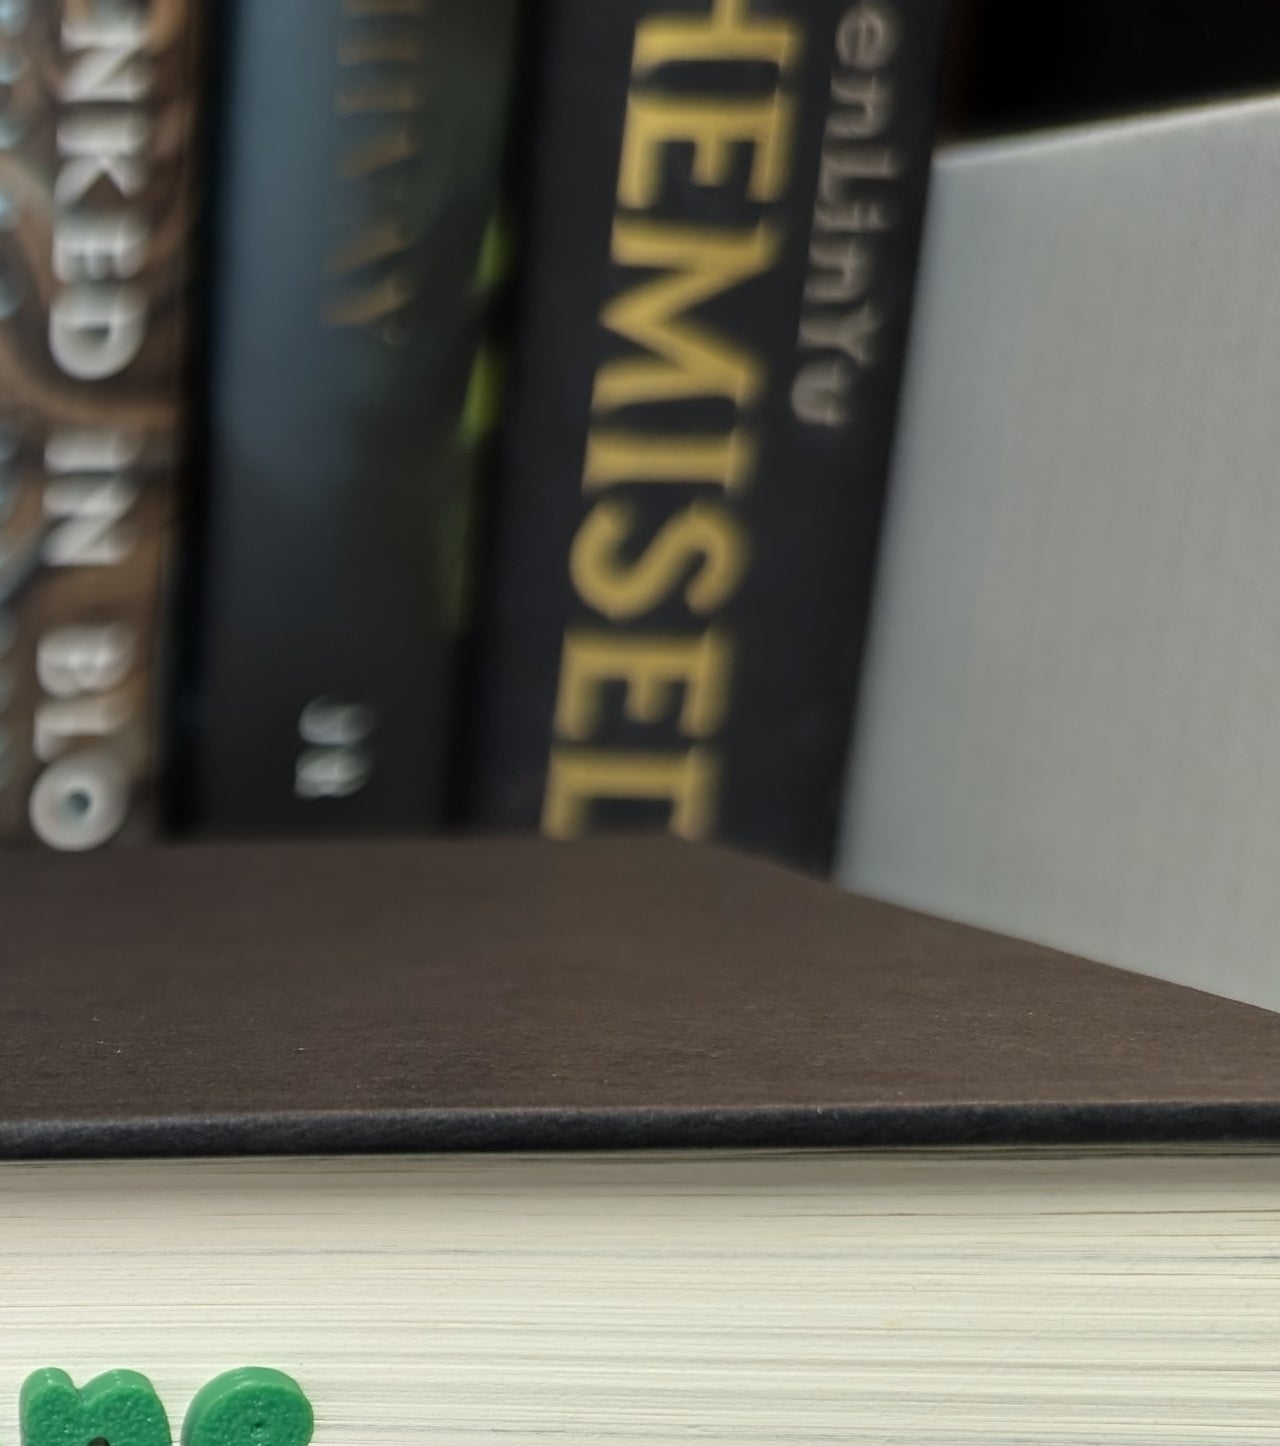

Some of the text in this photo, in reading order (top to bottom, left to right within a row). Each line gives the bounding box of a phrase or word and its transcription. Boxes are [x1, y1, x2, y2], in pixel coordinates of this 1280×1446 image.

[28, 0, 152, 853] NKED IN BLO
